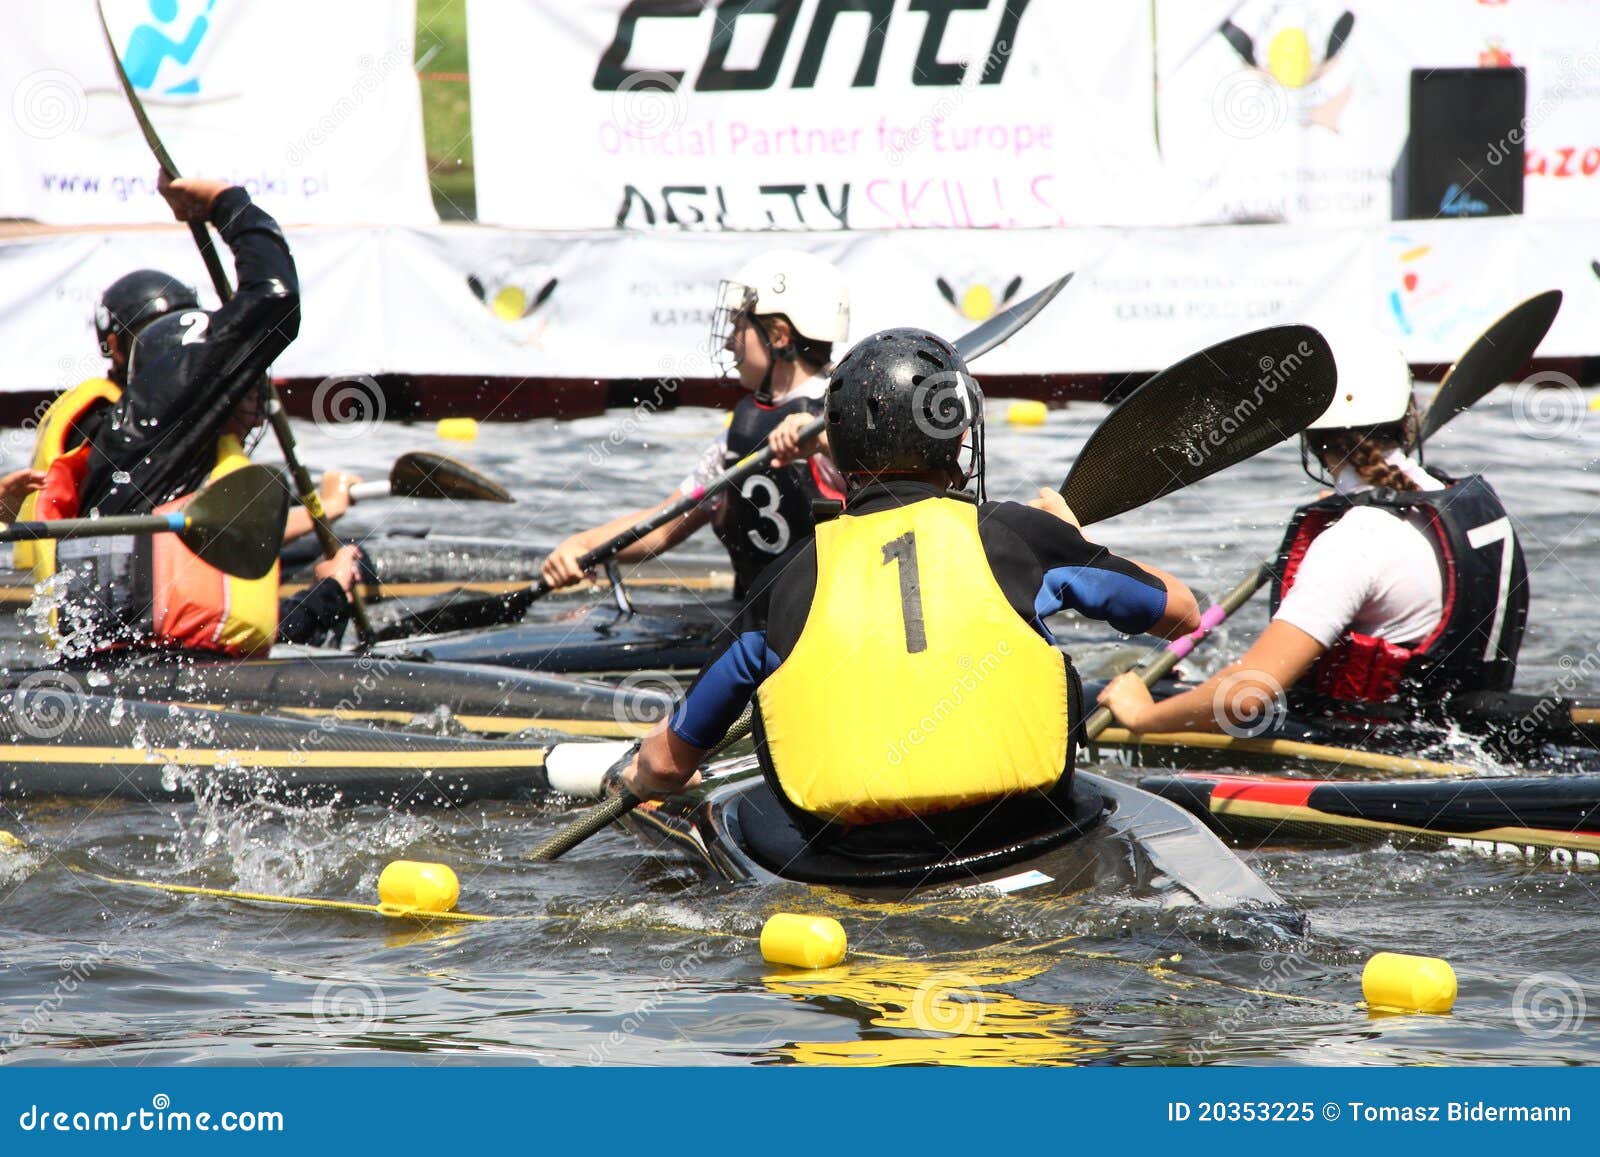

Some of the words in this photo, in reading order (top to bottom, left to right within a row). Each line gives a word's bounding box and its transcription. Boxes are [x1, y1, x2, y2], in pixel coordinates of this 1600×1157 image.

[728, 120, 863, 156] Partner
[772, 271, 788, 295] 3
[179, 312, 210, 345] 2
[741, 474, 791, 555] 3
[881, 530, 928, 654] 1
[1466, 516, 1514, 662] 7
